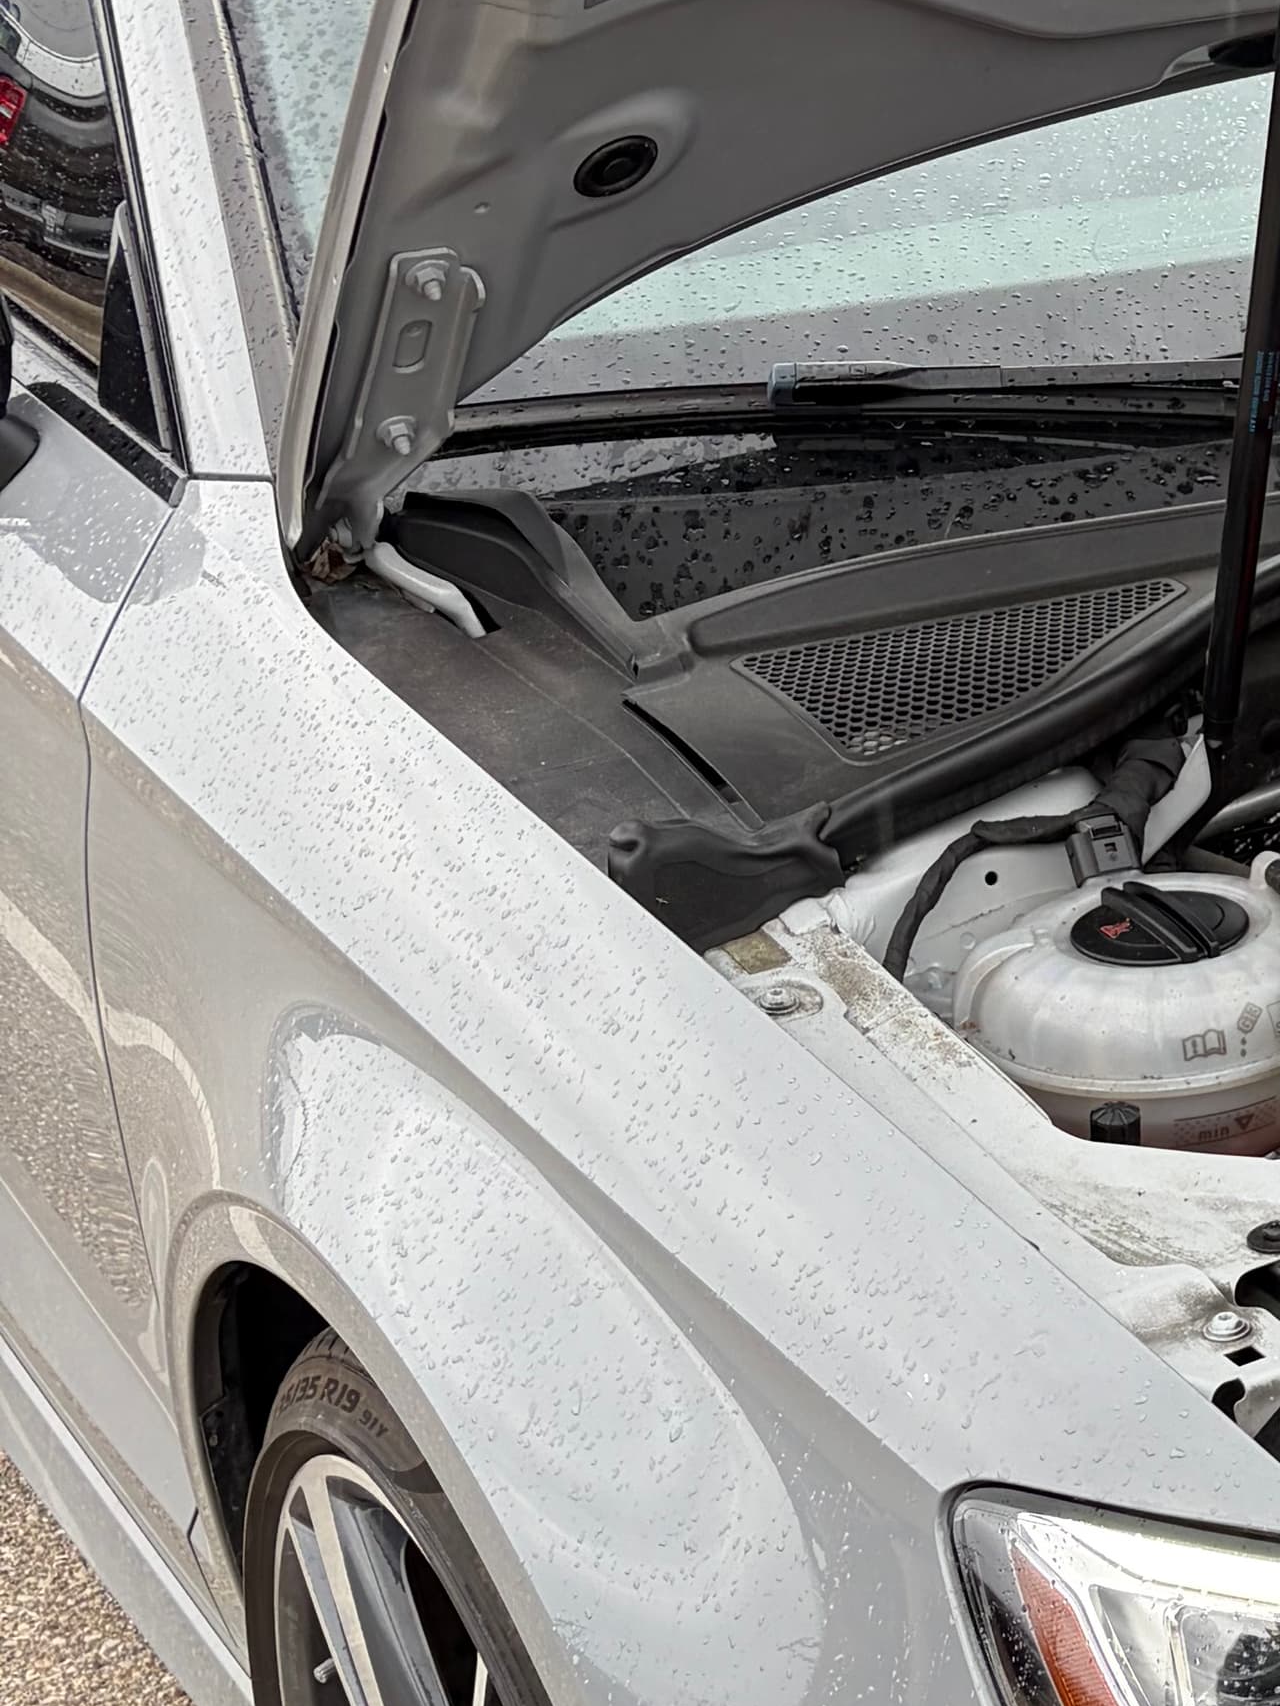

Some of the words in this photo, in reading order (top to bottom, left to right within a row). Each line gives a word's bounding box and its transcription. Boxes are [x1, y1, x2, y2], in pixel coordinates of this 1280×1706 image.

[1198, 1125, 1230, 1139] min
[320, 1377, 362, 1413] R19
[358, 1409, 389, 1437] 91Y
